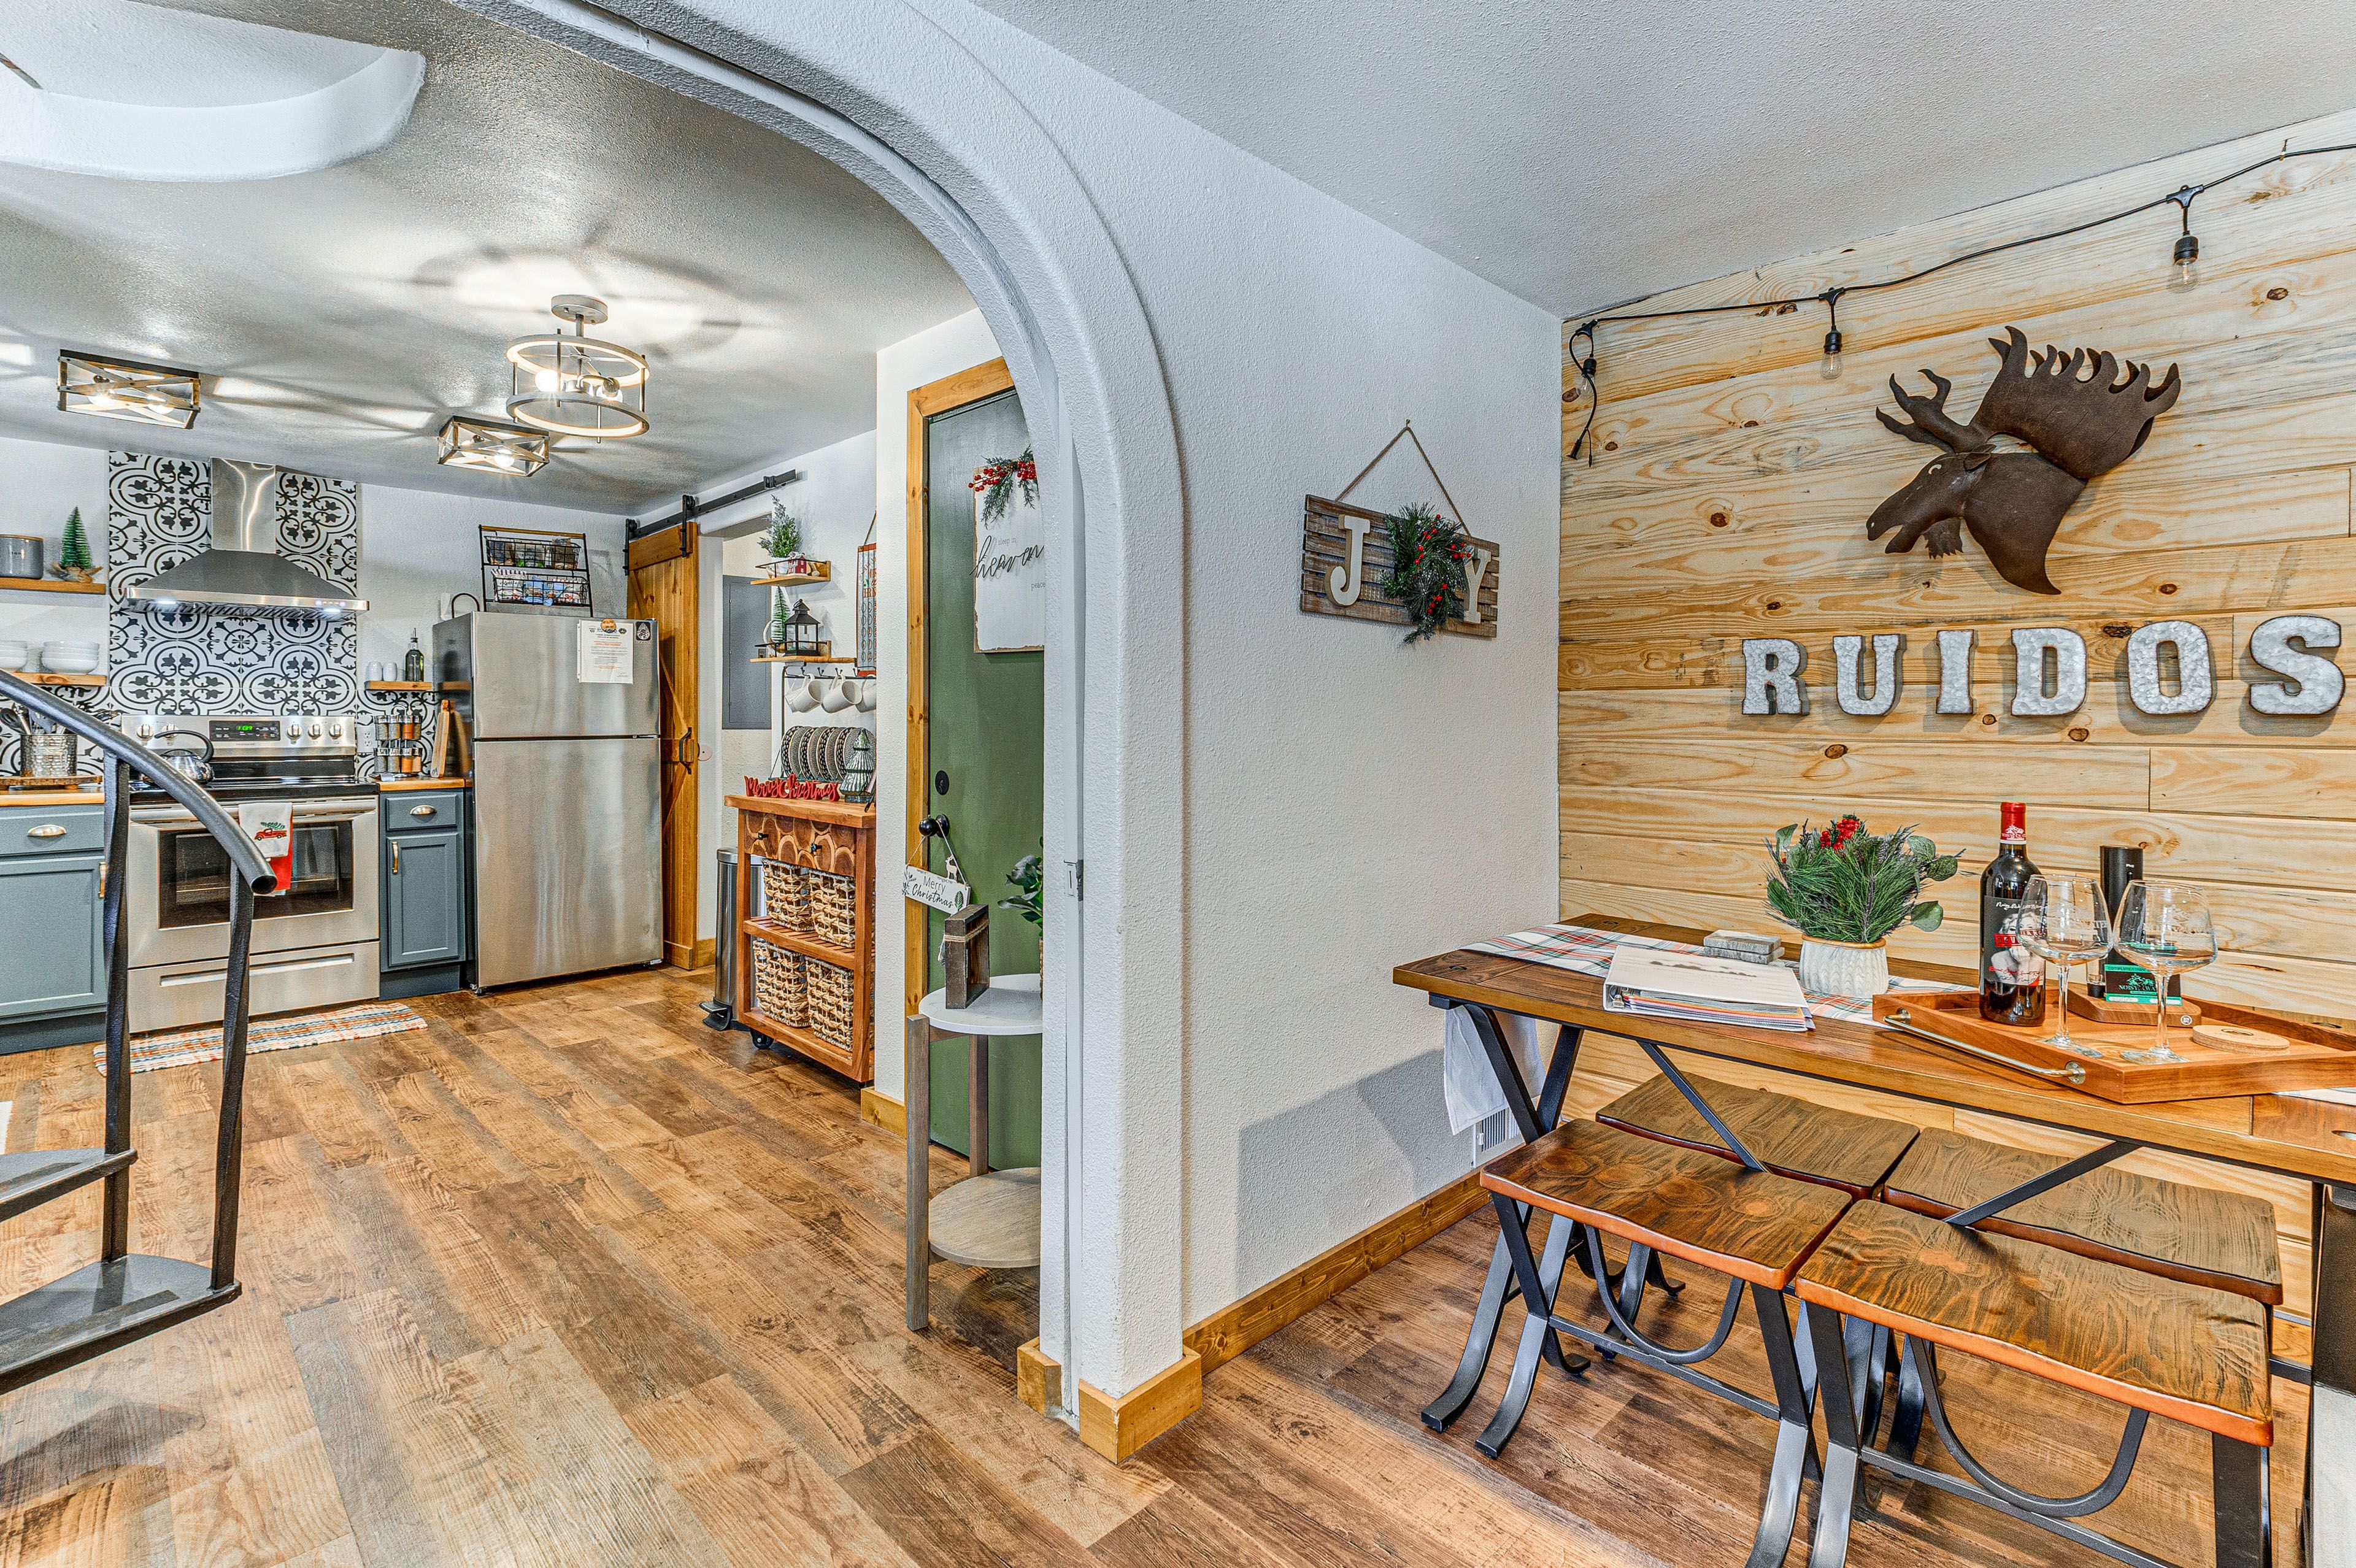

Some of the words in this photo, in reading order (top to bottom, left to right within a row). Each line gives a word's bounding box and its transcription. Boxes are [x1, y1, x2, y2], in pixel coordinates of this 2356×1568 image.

[1741, 615, 2346, 716] RUIDOS
[912, 883, 953, 909] Christmas
[923, 875, 946, 895] Merry
